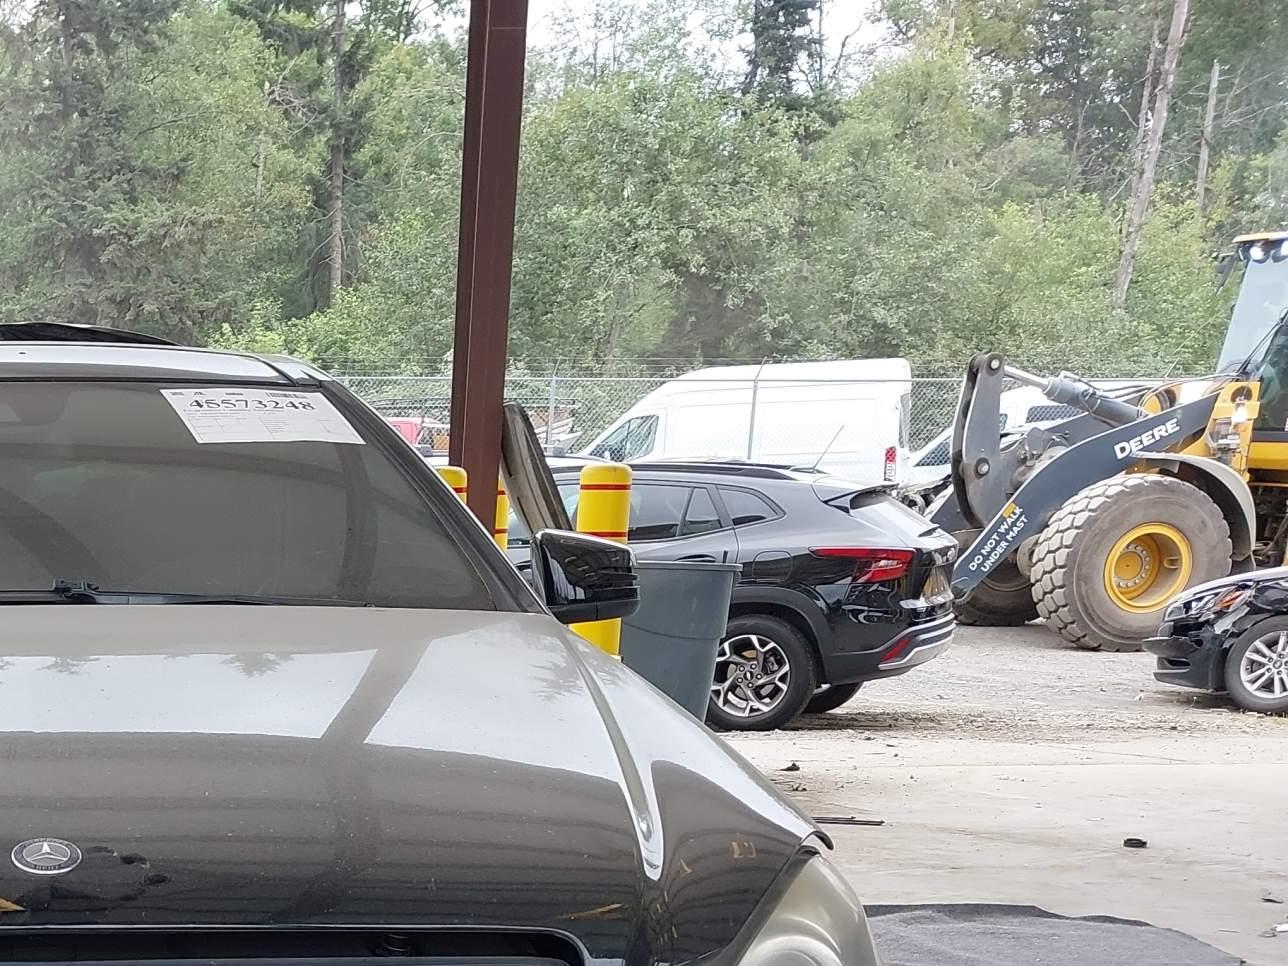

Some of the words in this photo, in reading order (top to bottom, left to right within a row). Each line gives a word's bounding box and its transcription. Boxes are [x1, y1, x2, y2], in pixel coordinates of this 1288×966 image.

[189, 399, 316, 410] 45573248
[1114, 418, 1180, 459] DEERE
[968, 555, 983, 571] DO
[981, 533, 1000, 555] NOT
[997, 506, 1023, 533] WALK
[980, 541, 1009, 572] UNDER
[1006, 515, 1028, 541] MAST
